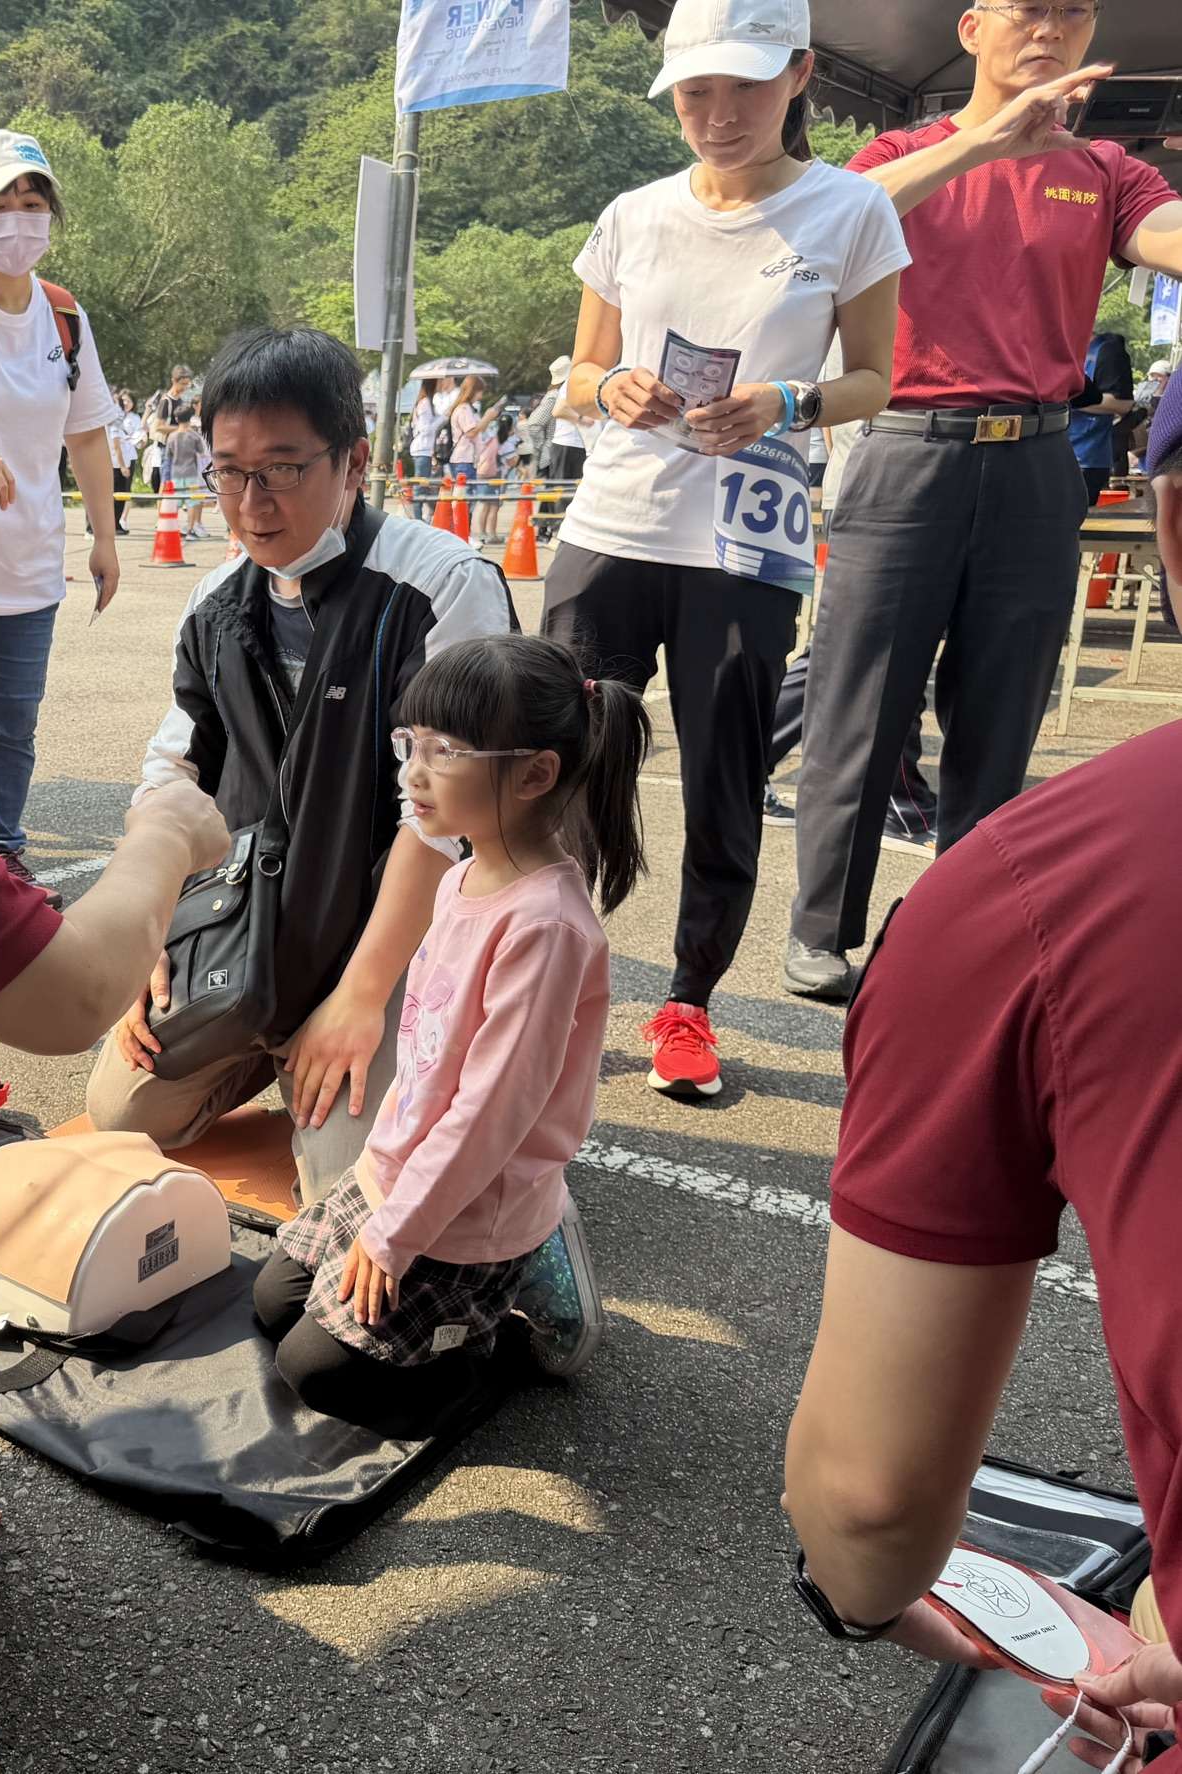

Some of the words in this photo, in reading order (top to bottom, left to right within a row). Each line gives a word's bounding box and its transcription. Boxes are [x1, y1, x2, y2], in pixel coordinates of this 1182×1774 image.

[1044, 186, 1098, 204] 桃園消防
[793, 269, 820, 283] FSP
[720, 471, 809, 545] 130
[1011, 1630, 1041, 1641] TRAINING
[1040, 1624, 1058, 1633] ONLY
